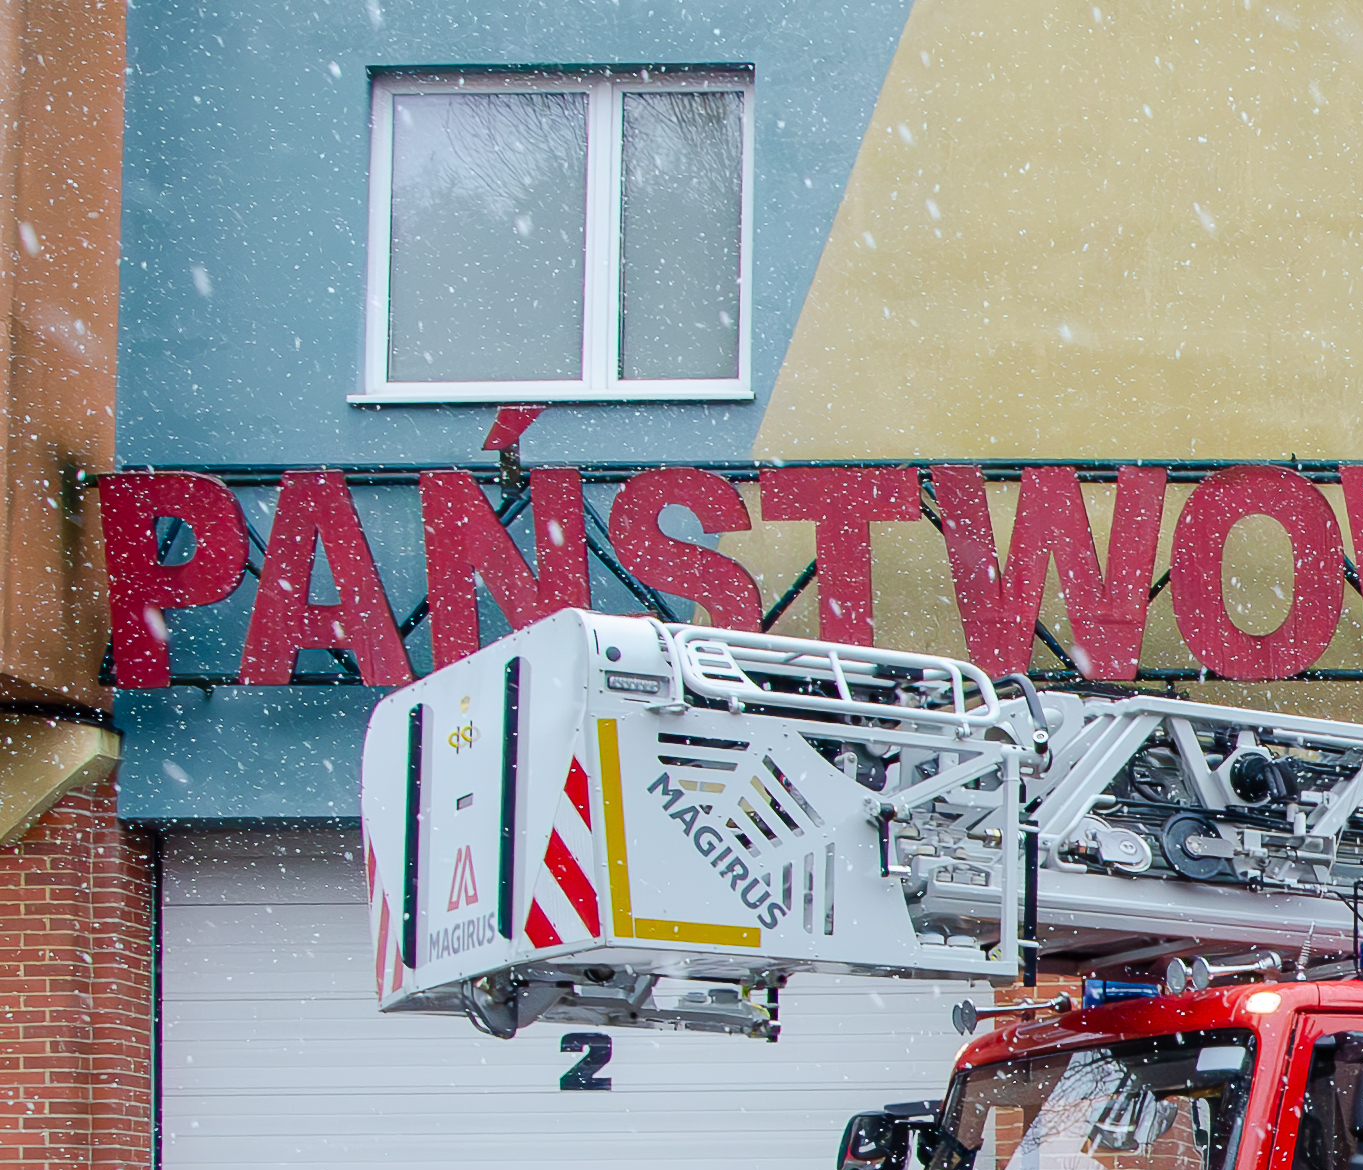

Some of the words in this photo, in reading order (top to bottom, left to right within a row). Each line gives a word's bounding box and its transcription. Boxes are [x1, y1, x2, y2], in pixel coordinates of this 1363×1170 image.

[647, 771, 787, 930] MAGIRUS
[429, 911, 495, 963] MAGIRUS
[560, 1032, 613, 1091] 2
